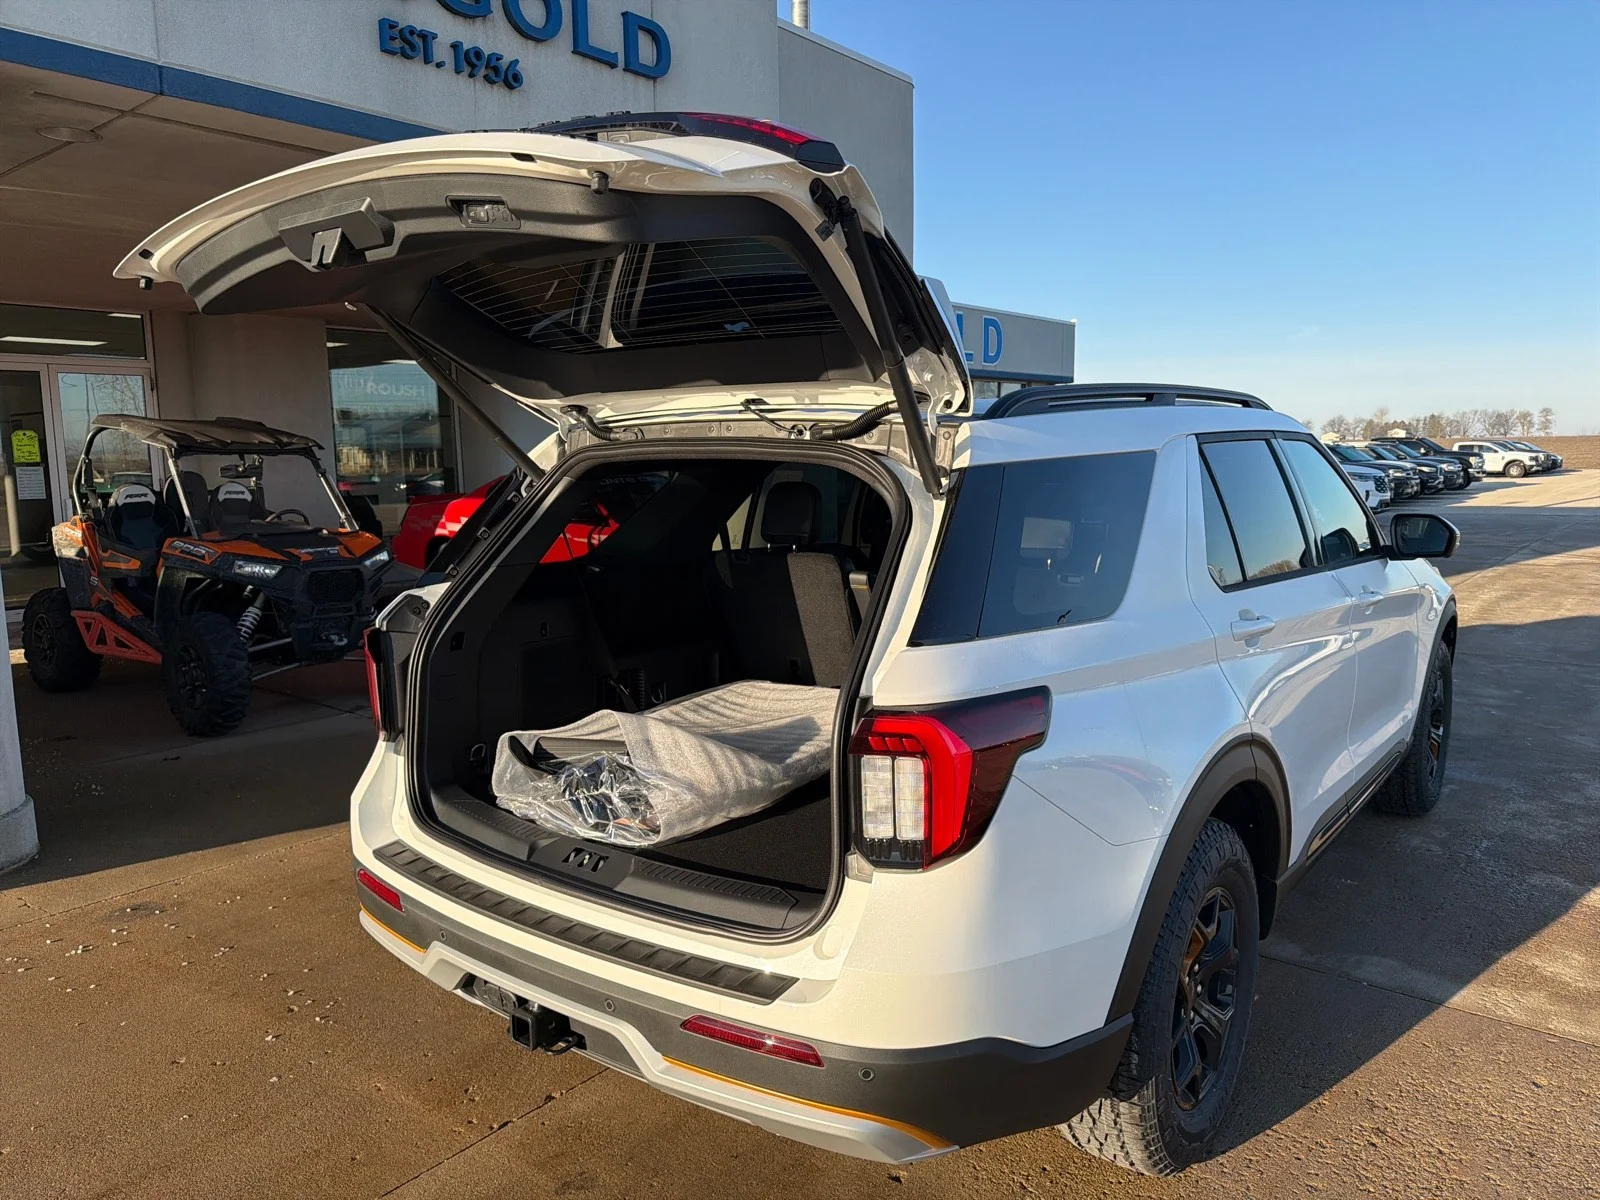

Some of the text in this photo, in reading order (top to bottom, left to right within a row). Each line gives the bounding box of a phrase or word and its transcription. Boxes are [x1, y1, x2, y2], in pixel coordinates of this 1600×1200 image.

[378, 17, 524, 90] EST. 1956
[366, 382, 425, 397] ROUSH
